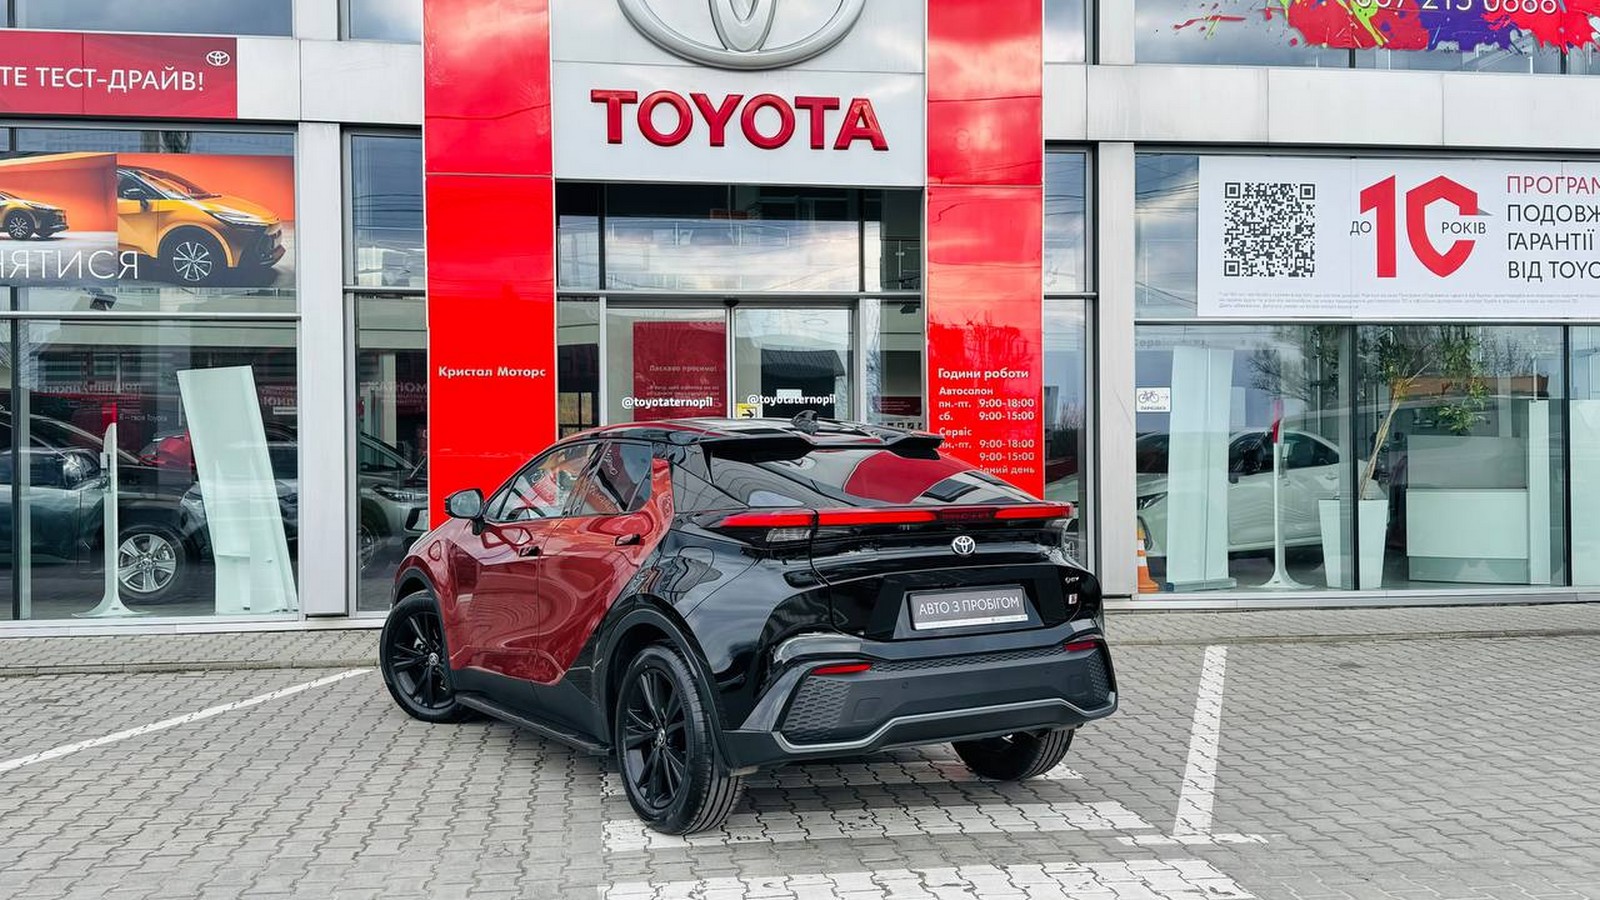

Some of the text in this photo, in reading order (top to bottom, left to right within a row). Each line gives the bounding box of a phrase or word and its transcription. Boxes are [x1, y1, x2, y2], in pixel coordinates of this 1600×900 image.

[0, 66, 204, 92] ТЕ ТЕСТ-ДРАЙВ!
[590, 89, 889, 151] TOYOTA
[1507, 204, 1600, 226] ПОДОВЖ
[1350, 221, 1372, 236] ДО
[1441, 222, 1487, 235] РОКІВ
[1507, 228, 1595, 251] ГАРАНТІЇ
[0, 249, 139, 279] ЯТИСЯ
[1508, 260, 1600, 282] ВІД TOYO
[438, 366, 547, 378] Кристал Моторс
[938, 367, 1029, 381] Години роботи
[939, 386, 994, 396] Автосалон
[621, 395, 714, 410] @toyotaternopil
[746, 393, 837, 407] @toyotaternopil
[939, 398, 1035, 409] пн.-пт. 9:00-18:00
[939, 411, 1035, 421] сб. 9:00-15:00
[939, 427, 973, 439] Сервіс
[979, 439, 1035, 449] 9:00-18:00
[979, 452, 1035, 461] 9:00-15:00
[1010, 466, 1035, 475] день
[919, 601, 950, 616] АВТО
[962, 596, 1020, 612] ПРОБІГОМ
